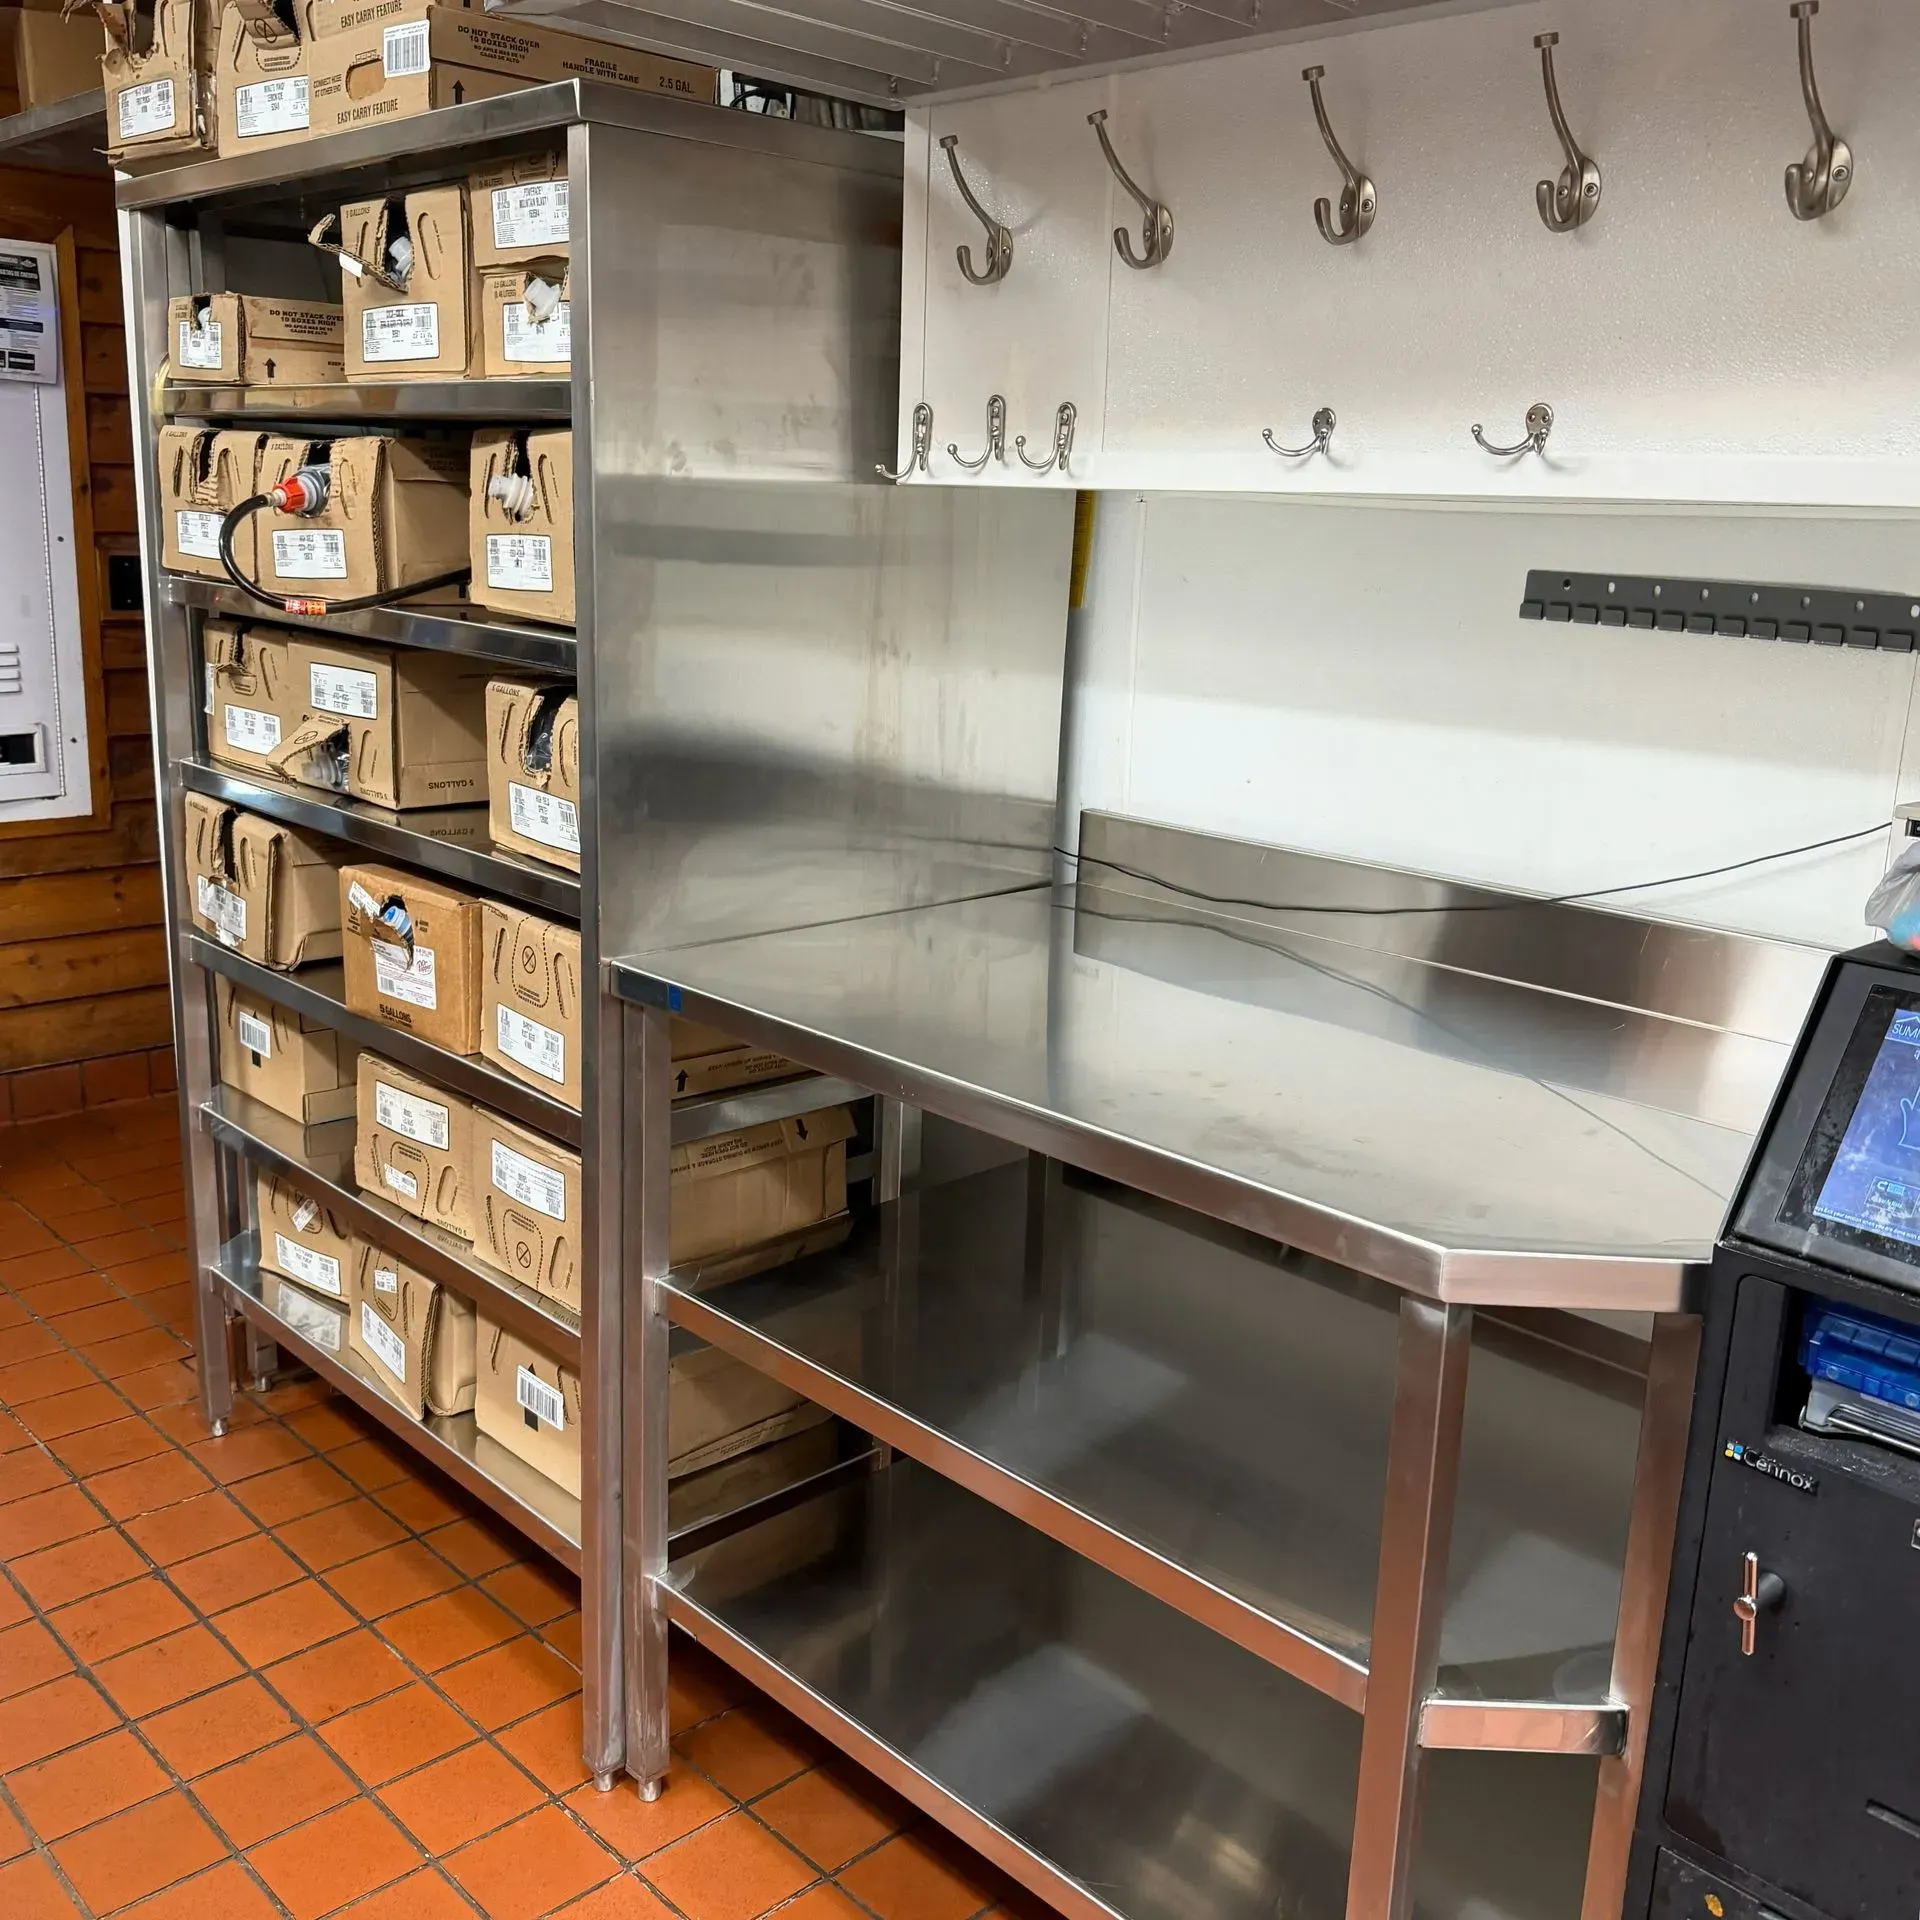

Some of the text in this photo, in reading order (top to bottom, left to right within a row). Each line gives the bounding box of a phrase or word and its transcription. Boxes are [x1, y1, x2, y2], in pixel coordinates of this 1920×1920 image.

[340, 1, 402, 29] EASY CARRY FEATURE
[457, 25, 540, 48] DO NOT STACK OVER
[470, 35, 529, 54] 10 BOXES HIGH
[562, 61, 640, 84] HANDLE WITH CARE
[584, 57, 618, 72] FRAGILE
[659, 76, 695, 94] 2.5 GAL.
[337, 99, 398, 125] EASY CARRY FEATURE
[350, 206, 371, 218] GALLONS
[269, 309, 280, 318] DO
[282, 310, 298, 319] NOT
[300, 312, 324, 320] STACK
[291, 317, 316, 325] BOXES
[317, 319, 337, 327] HIGH
[495, 685, 520, 697] GALLONS
[428, 780, 468, 790] GALLONS
[379, 1003, 386, 1014] 5
[385, 1005, 412, 1024] GALLONS
[436, 1218, 463, 1235] GALLONS
[1743, 1448, 1815, 1493] Cennox
